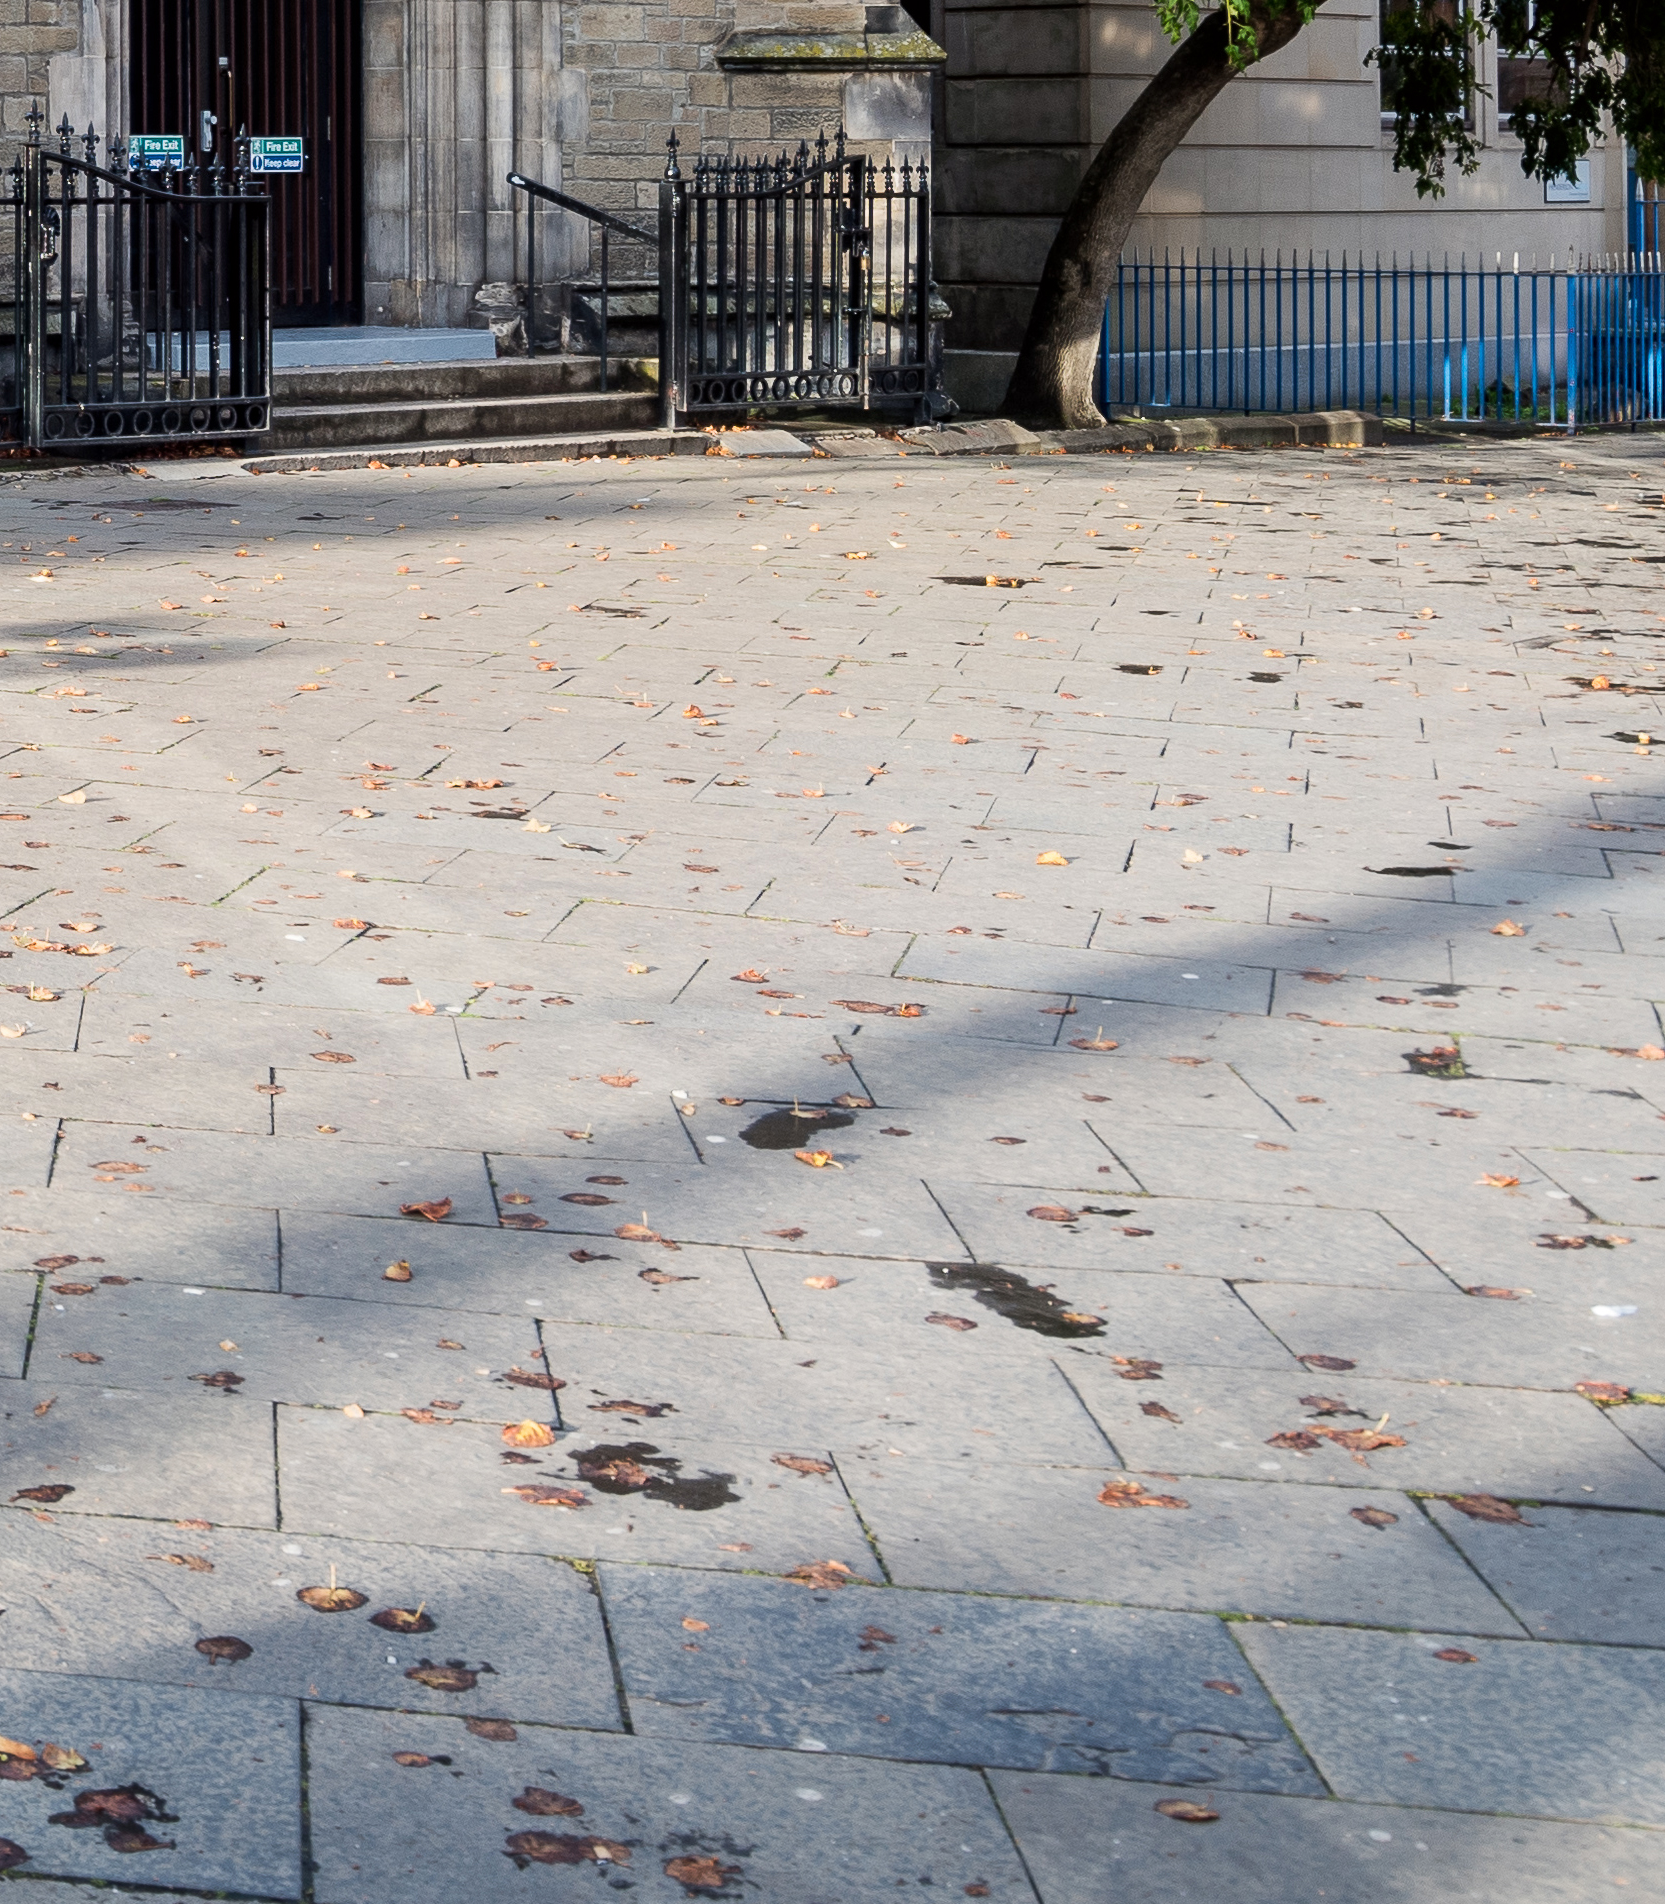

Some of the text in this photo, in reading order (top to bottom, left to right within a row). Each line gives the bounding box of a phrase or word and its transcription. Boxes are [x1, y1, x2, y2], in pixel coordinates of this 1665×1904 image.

[144, 139, 179, 150] Fire Exit
[266, 141, 298, 152] Fire Exit
[264, 157, 300, 169] Keep clear
